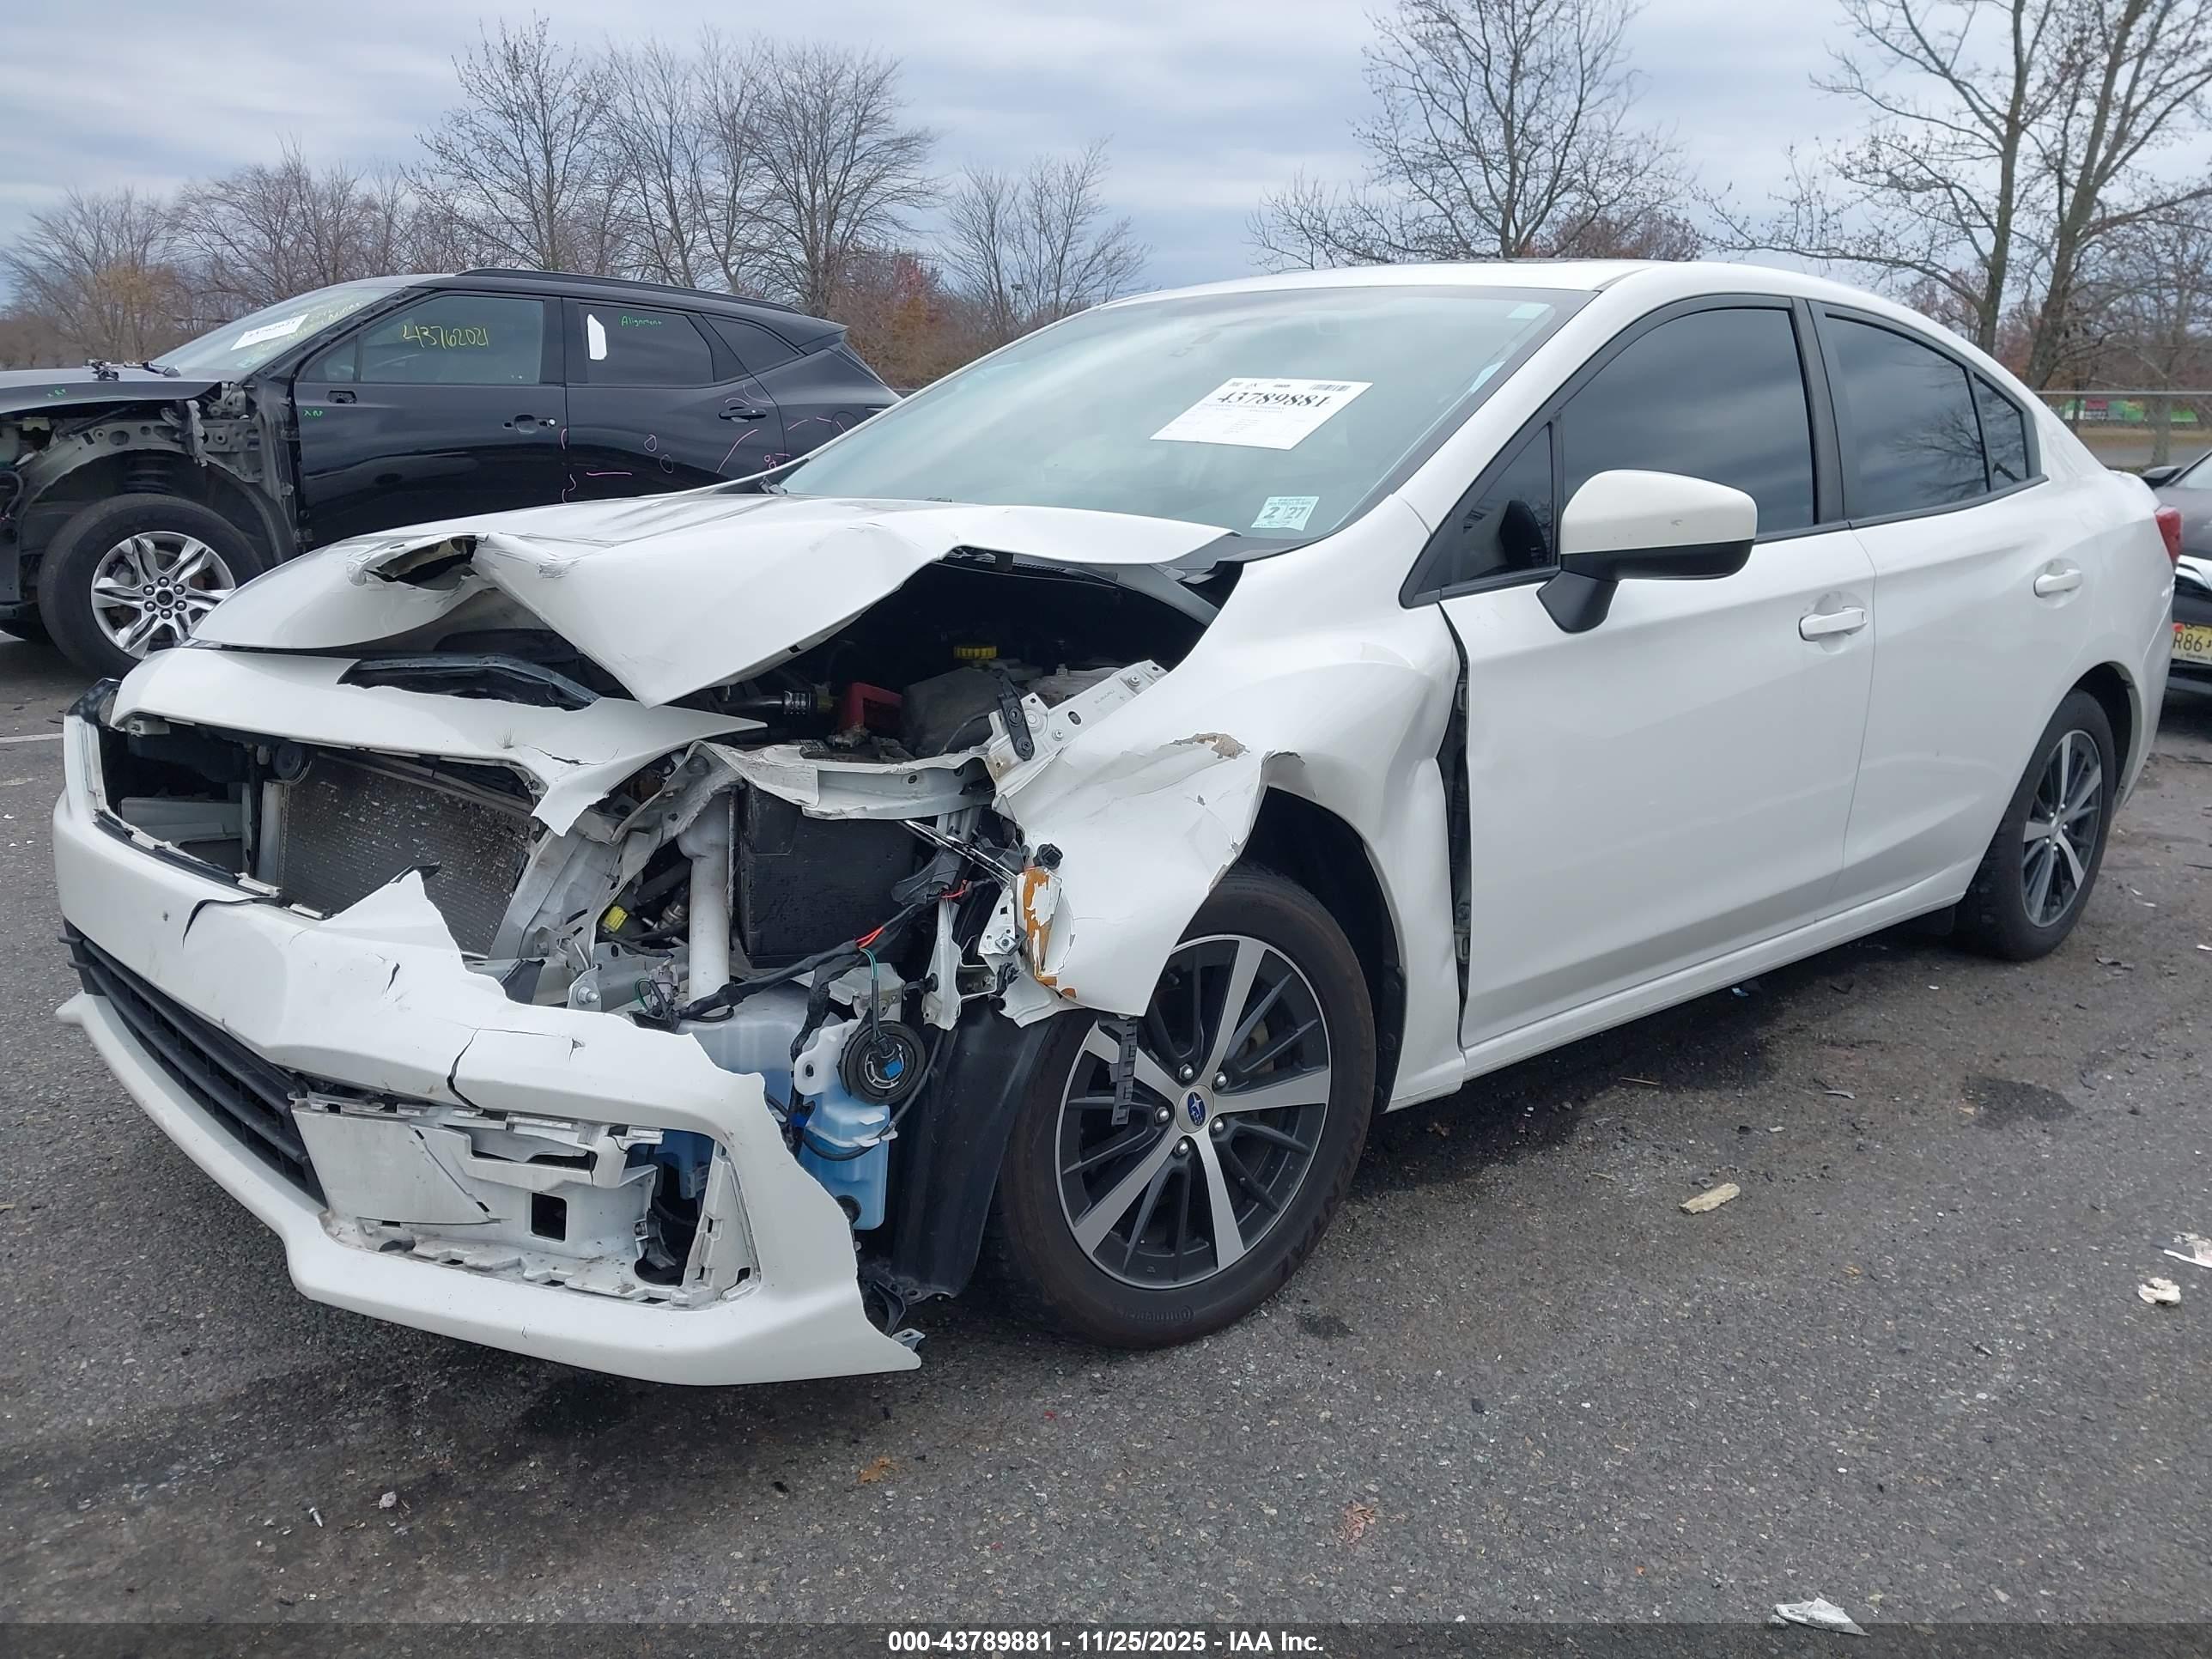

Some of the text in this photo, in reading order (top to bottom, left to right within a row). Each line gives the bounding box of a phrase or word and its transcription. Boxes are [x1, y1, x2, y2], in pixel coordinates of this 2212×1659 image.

[402, 324, 489, 350] 43762021
[1217, 392, 1331, 407] 43789881
[1263, 506, 1307, 520] 2 27
